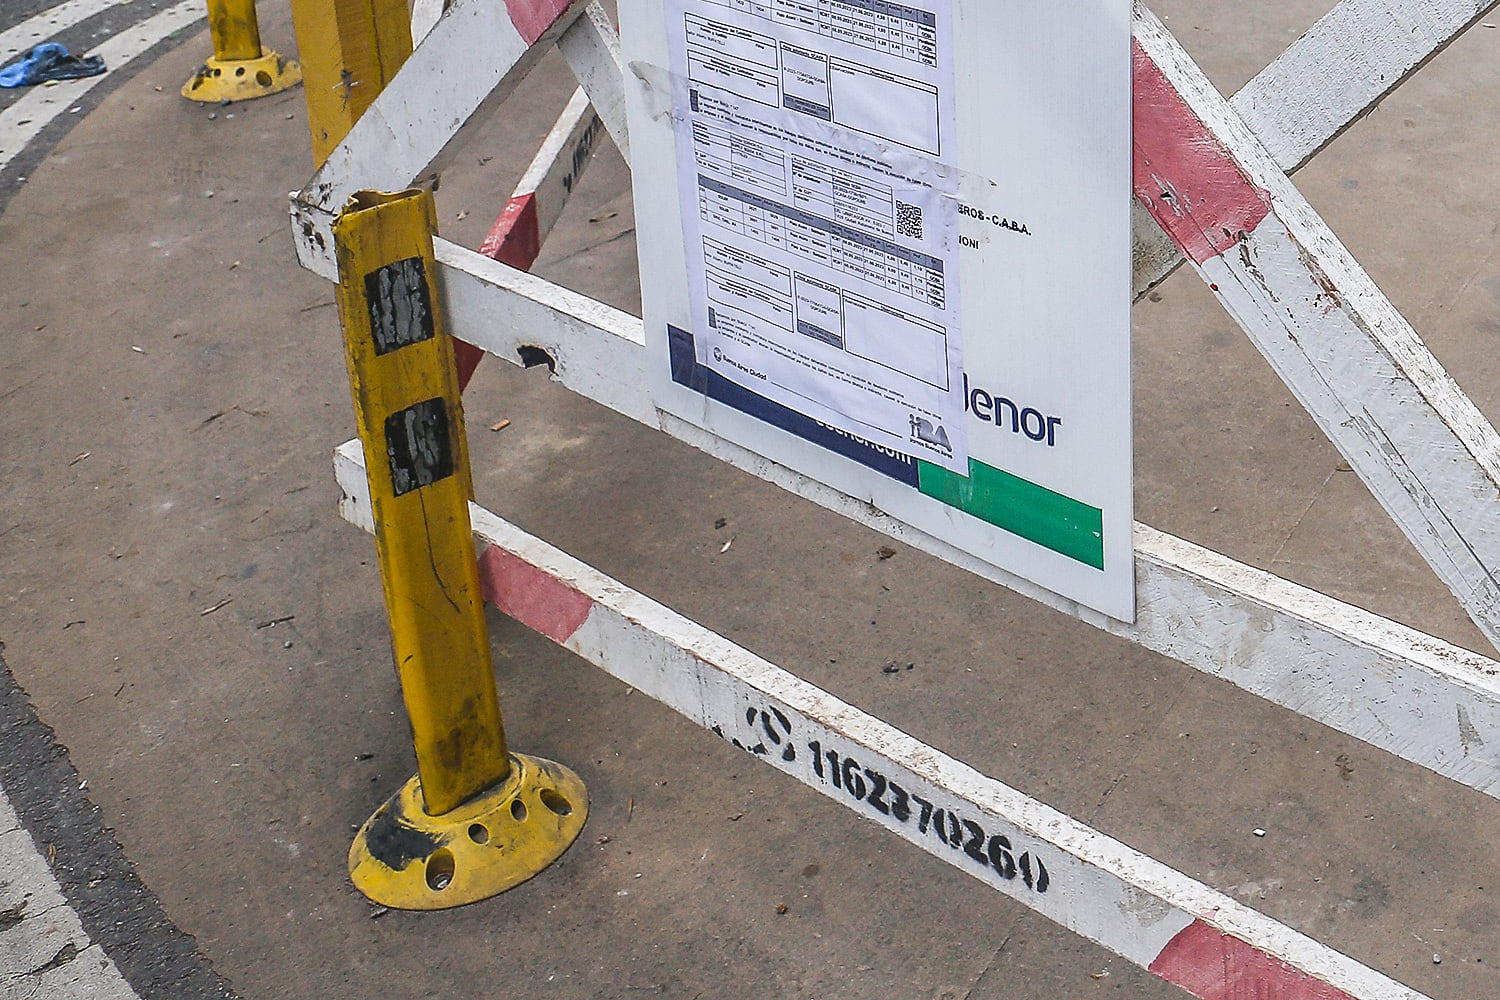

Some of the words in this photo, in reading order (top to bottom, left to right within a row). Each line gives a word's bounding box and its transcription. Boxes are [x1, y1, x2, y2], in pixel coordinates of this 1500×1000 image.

[958, 204, 984, 220] EROS
[959, 235, 979, 249] IONI
[963, 373, 1062, 446] enor
[807, 739, 1051, 894] 1162370260
